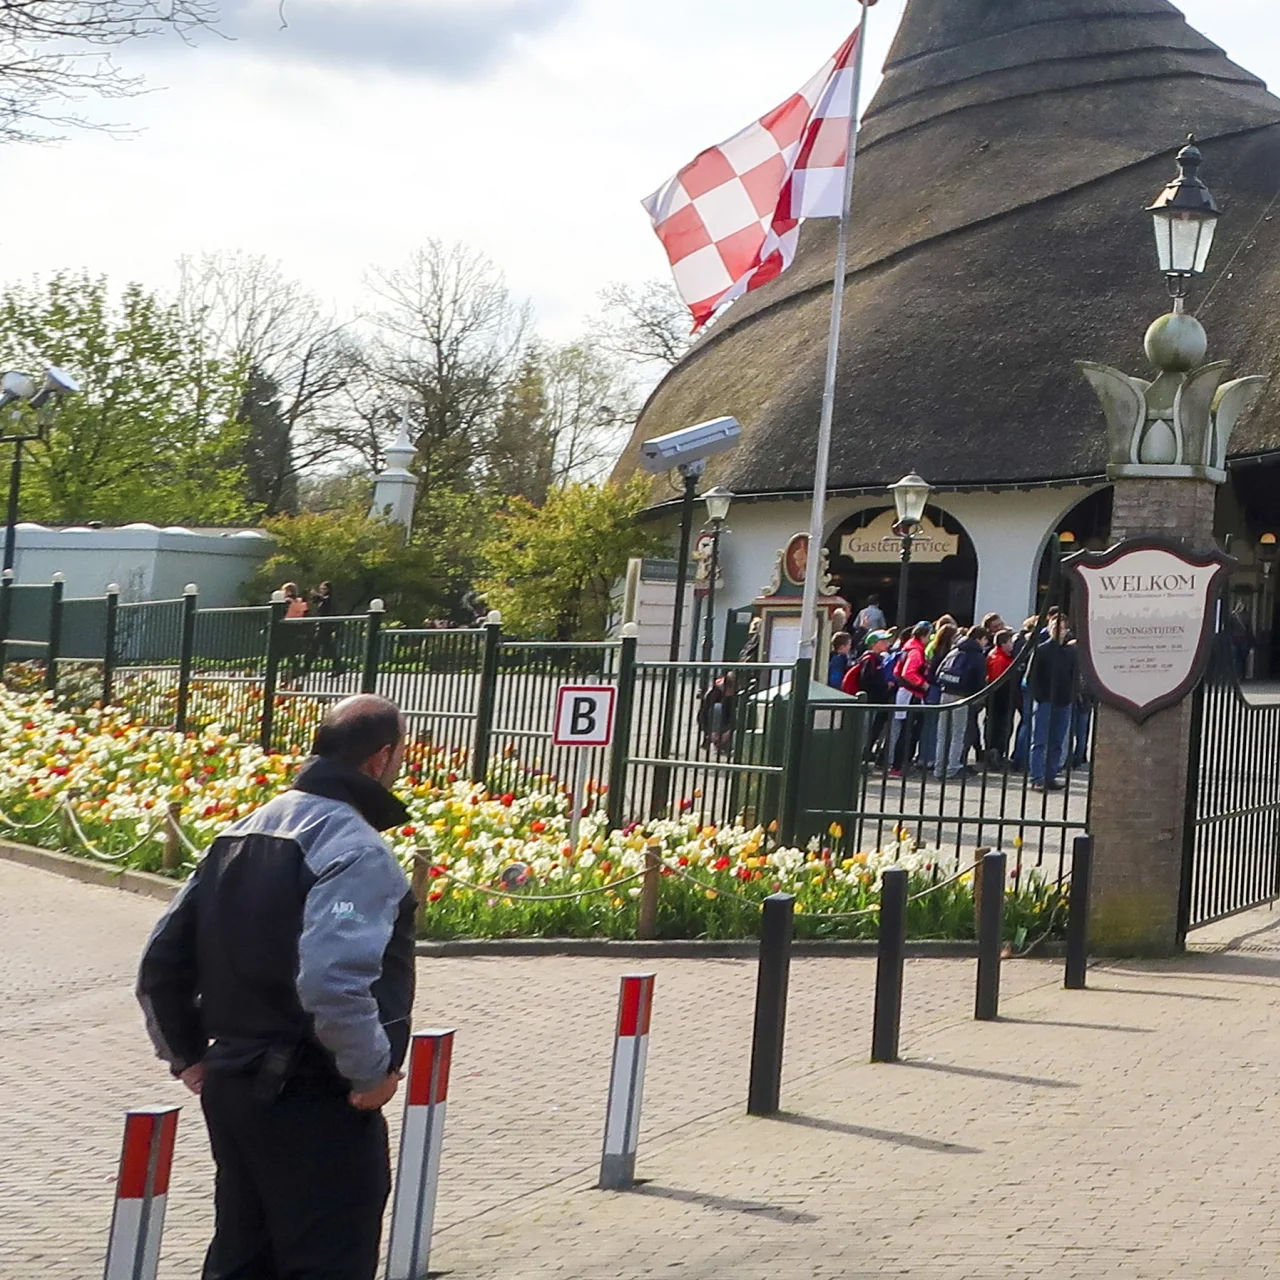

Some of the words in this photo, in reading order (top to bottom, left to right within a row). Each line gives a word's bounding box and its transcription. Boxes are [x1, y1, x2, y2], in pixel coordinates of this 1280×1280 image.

[848, 536, 952, 553] Gastenrvice
[1099, 574, 1196, 592] WELKOM
[1105, 625, 1185, 636] OPENINGSTIJDEN
[570, 697, 597, 735] B
